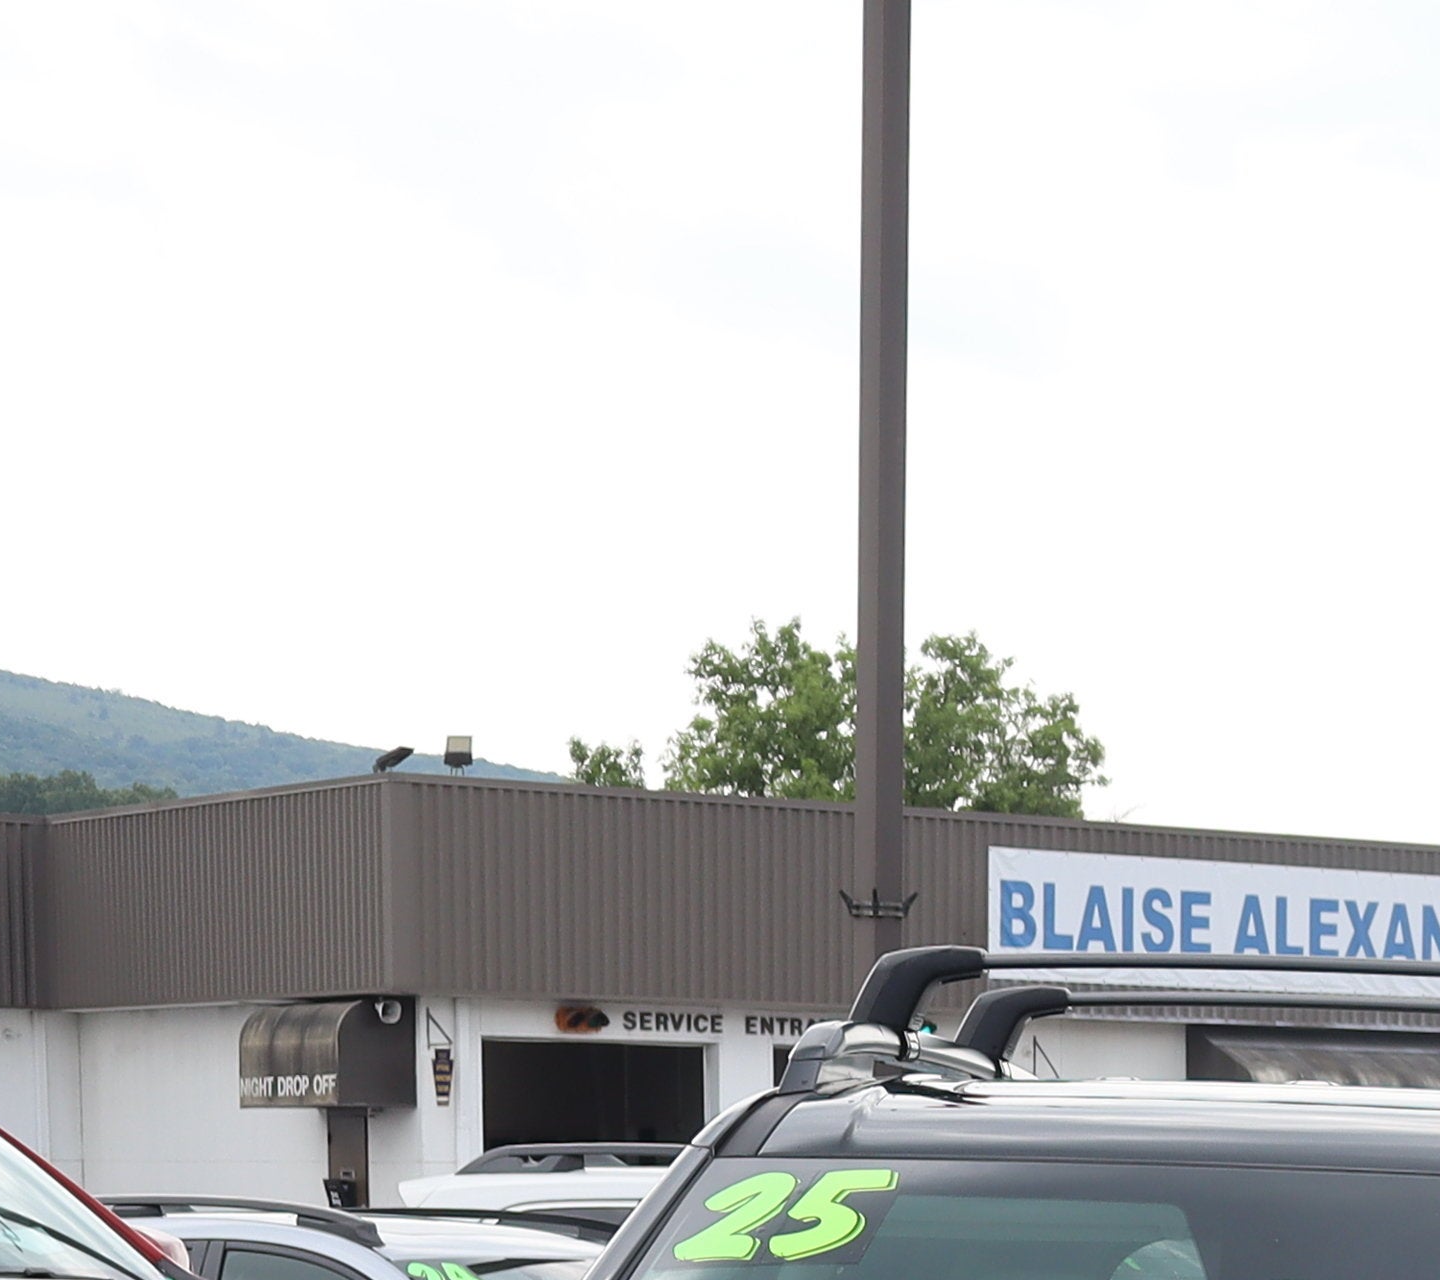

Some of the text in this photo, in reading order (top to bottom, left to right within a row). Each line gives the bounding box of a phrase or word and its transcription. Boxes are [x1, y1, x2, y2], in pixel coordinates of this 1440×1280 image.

[1000, 879, 1212, 954] BLAISE
[622, 1011, 724, 1034] SERVICE
[240, 1073, 338, 1098] NIGHT DROP OFF
[673, 1168, 900, 1262] 25
